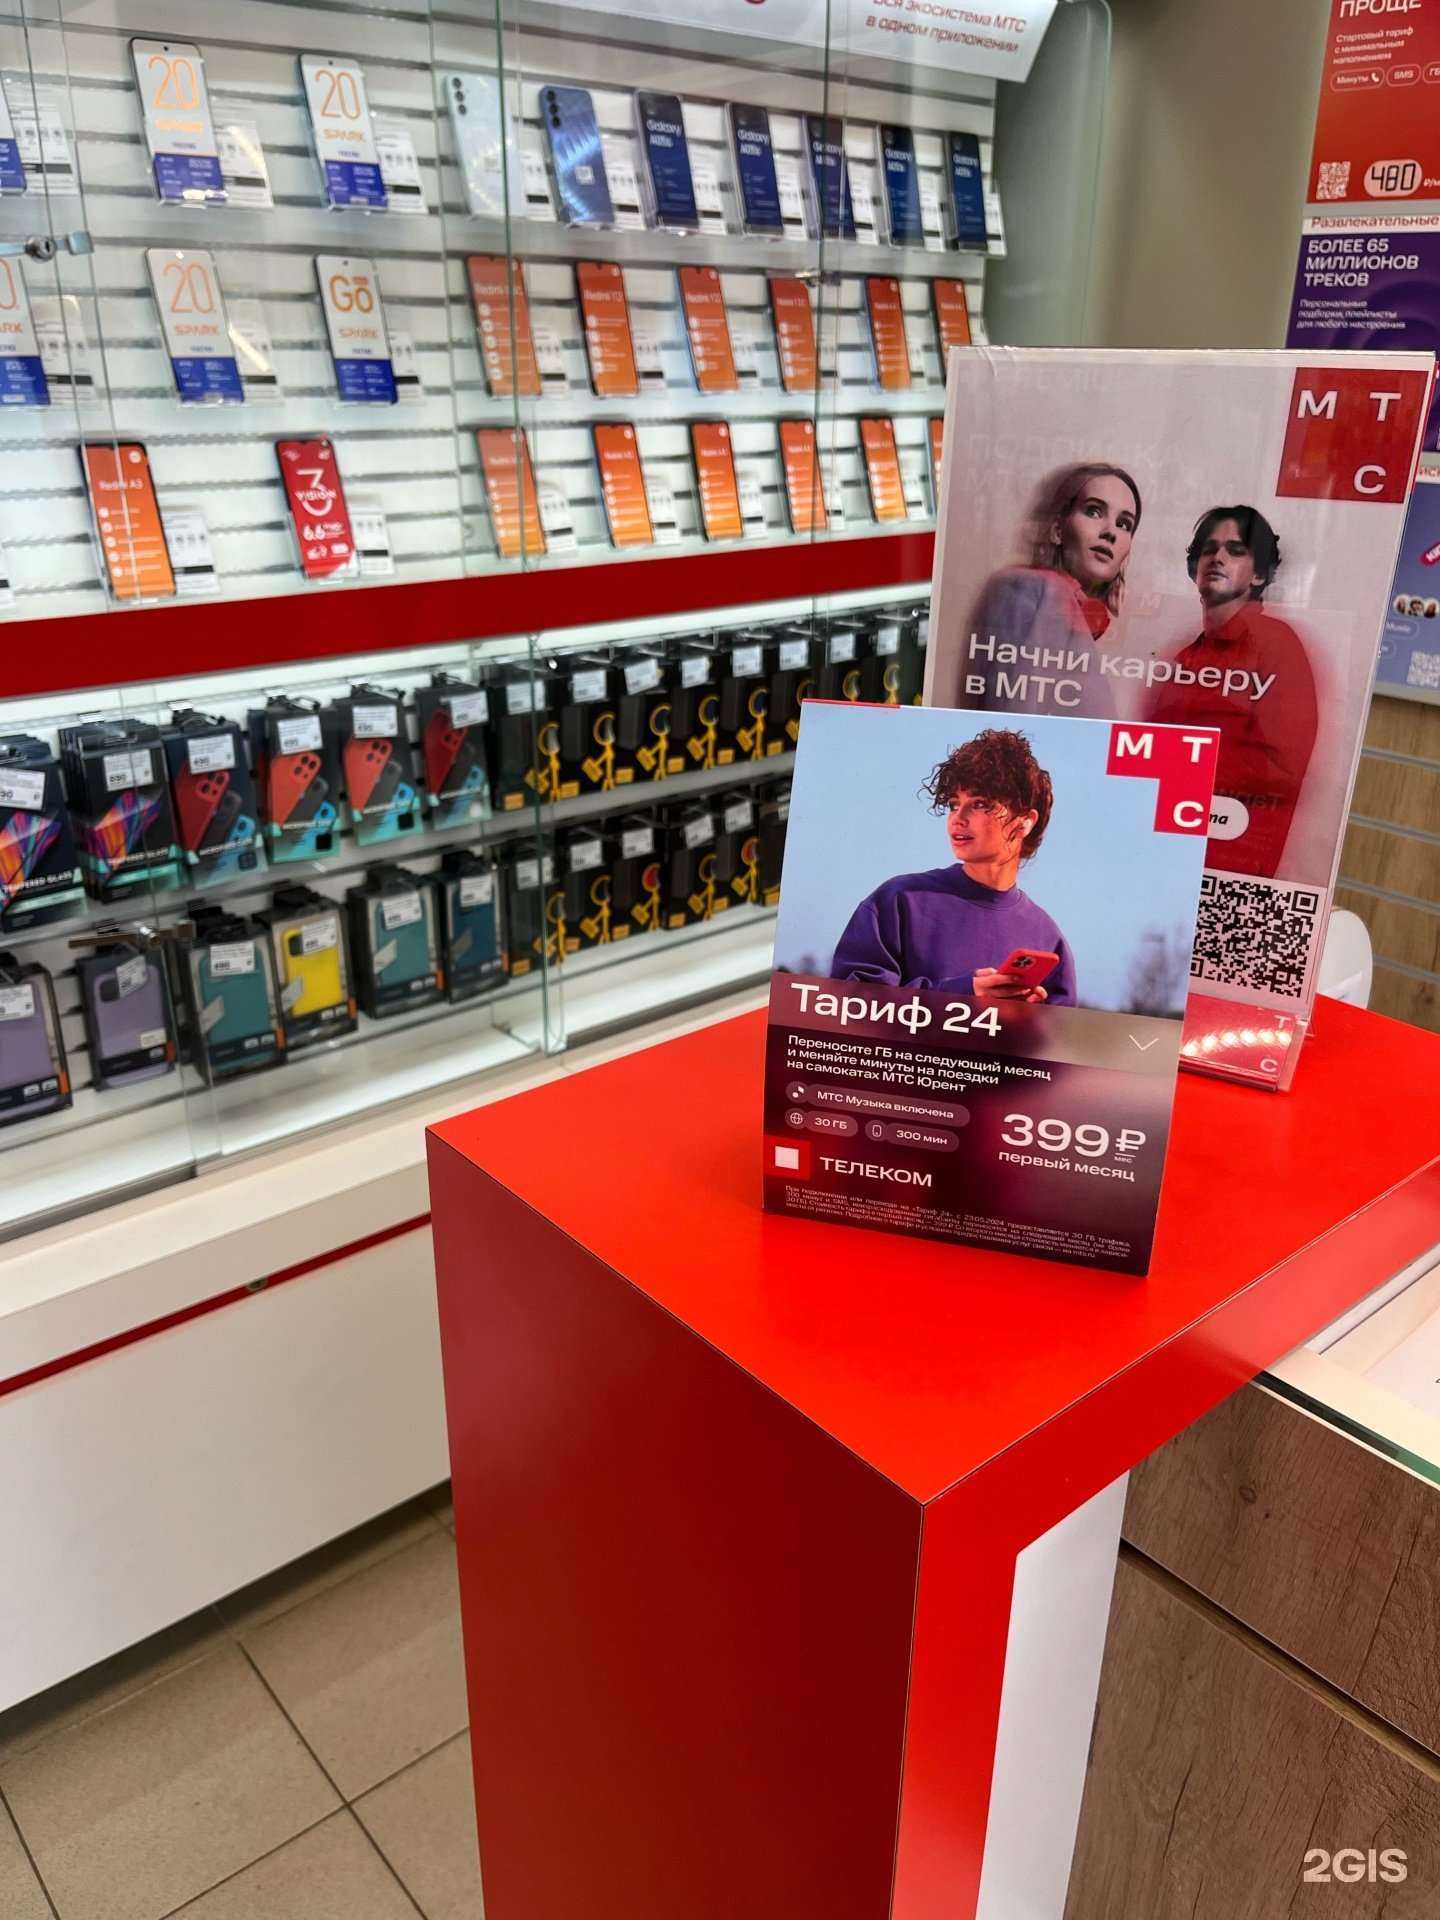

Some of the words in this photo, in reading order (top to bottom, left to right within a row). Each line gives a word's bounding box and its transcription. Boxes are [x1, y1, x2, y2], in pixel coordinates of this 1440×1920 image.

[905, 2, 993, 26] экосистема
[993, 15, 1027, 33] МТС
[865, 15, 876, 27] в
[878, 17, 928, 36] одном
[929, 27, 1019, 52] приложении
[1336, 30, 1384, 43] Стартовый
[1386, 26, 1414, 37] тариф
[1337, 76, 1369, 84] Минуты
[1394, 70, 1414, 80] SMS
[315, 68, 361, 120] 20
[1371, 163, 1416, 192] 480
[1311, 216, 1440, 229] Развлекательные
[1308, 239, 1365, 254] БОЛЕЕ
[1367, 238, 1389, 253] 65
[1305, 255, 1419, 270] МИЛЛИОНОВ
[163, 262, 214, 313] 20
[1304, 272, 1370, 287] ТРЕКОВ
[968, 632, 1090, 673] Начни
[1100, 653, 1276, 701] карьеру
[965, 674, 986, 696] в
[994, 671, 1084, 708] МТС
[790, 982, 932, 1035] Тариф
[942, 1002, 1002, 1037] 24
[787, 1049, 797, 1057] и
[799, 1050, 858, 1066] меняйте
[860, 1059, 915, 1075] минуты
[917, 1066, 935, 1077] на
[937, 1069, 999, 1085] поездки
[788, 1034, 872, 1056] Переносите
[875, 1047, 892, 1059] ГБ
[895, 1051, 913, 1062] на
[915, 1054, 1001, 1073] следующий
[1004, 1065, 1051, 1081] месяц
[787, 1060, 804, 1070] на
[806, 1062, 880, 1081] самокатах
[882, 1071, 915, 1086] МТС
[917, 1075, 966, 1093] Юрент
[817, 1091, 844, 1102] МТС
[845, 1096, 892, 1112] Музыка
[894, 1104, 954, 1119] включена
[814, 1117, 831, 1128] 30
[832, 1119, 848, 1130] ГБ
[896, 1129, 921, 1141] 300
[923, 1134, 948, 1145] мин
[1001, 1113, 1110, 1158] 399
[819, 1156, 933, 1188] ТЕЛЕКОМ
[999, 1151, 1071, 1172] первый
[1074, 1163, 1136, 1183] месяц
